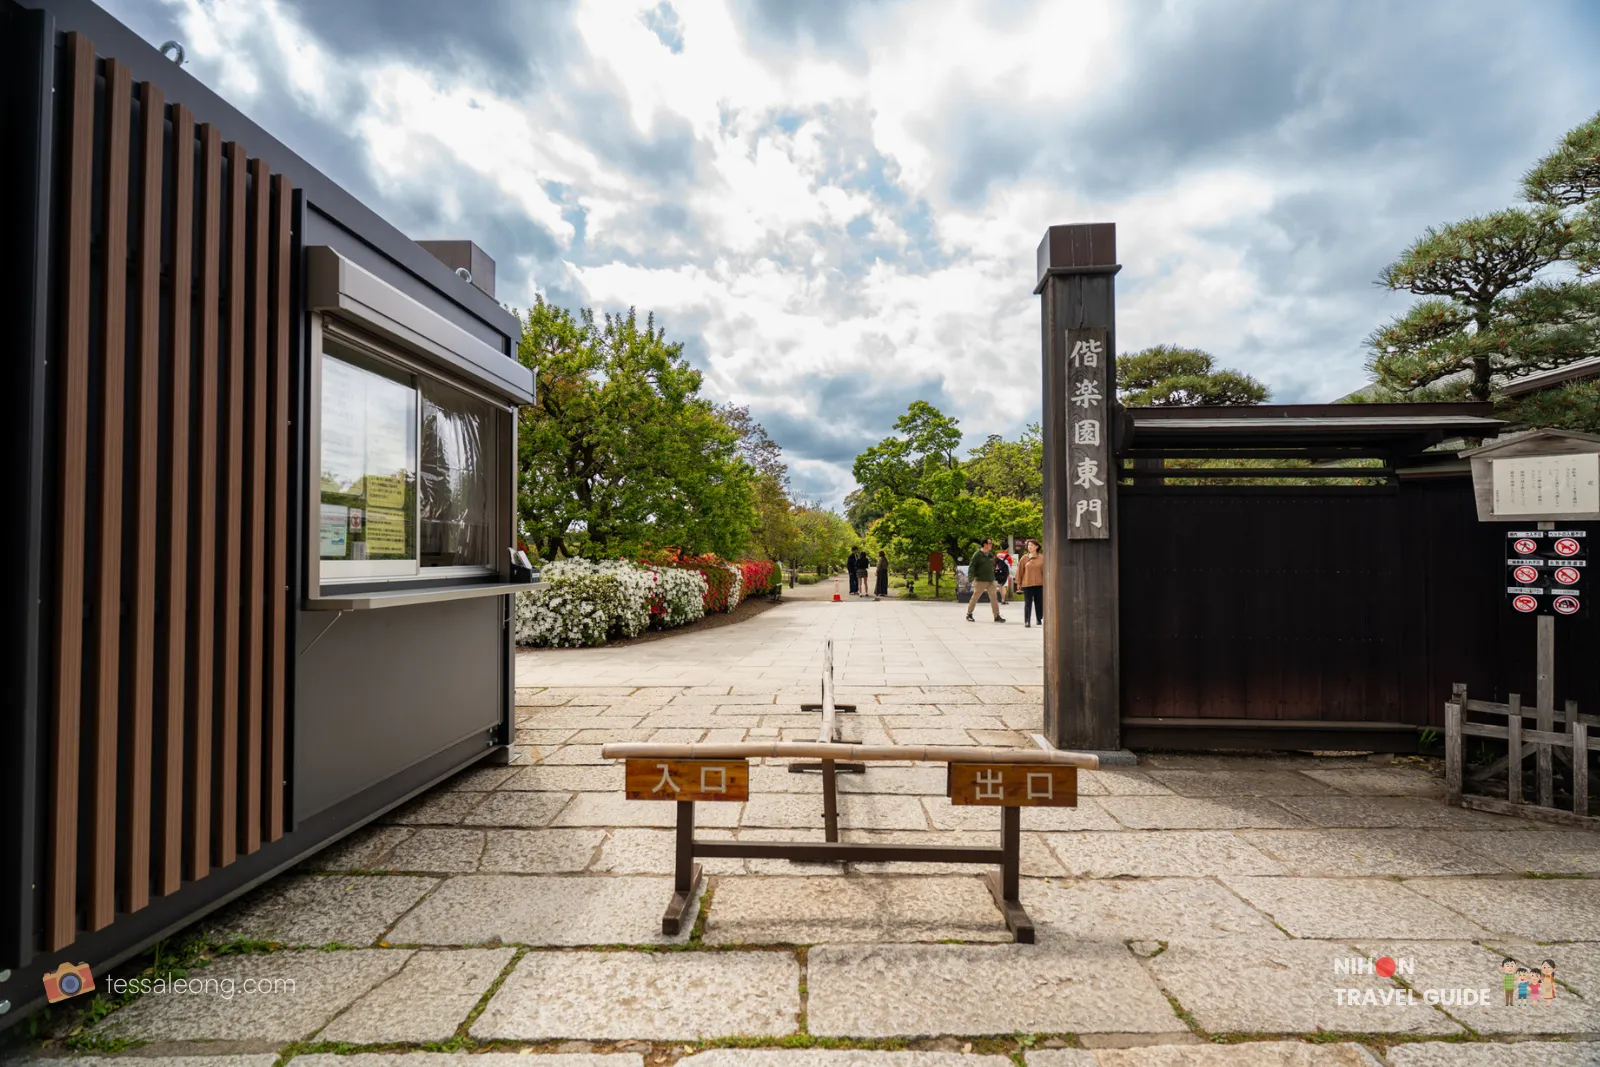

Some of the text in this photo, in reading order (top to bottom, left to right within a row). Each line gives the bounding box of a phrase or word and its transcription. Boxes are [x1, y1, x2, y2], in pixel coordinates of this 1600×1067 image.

[1070, 339, 1104, 528] 偕楽園東門
[652, 763, 726, 793] 入口
[976, 768, 1053, 800] 出口
